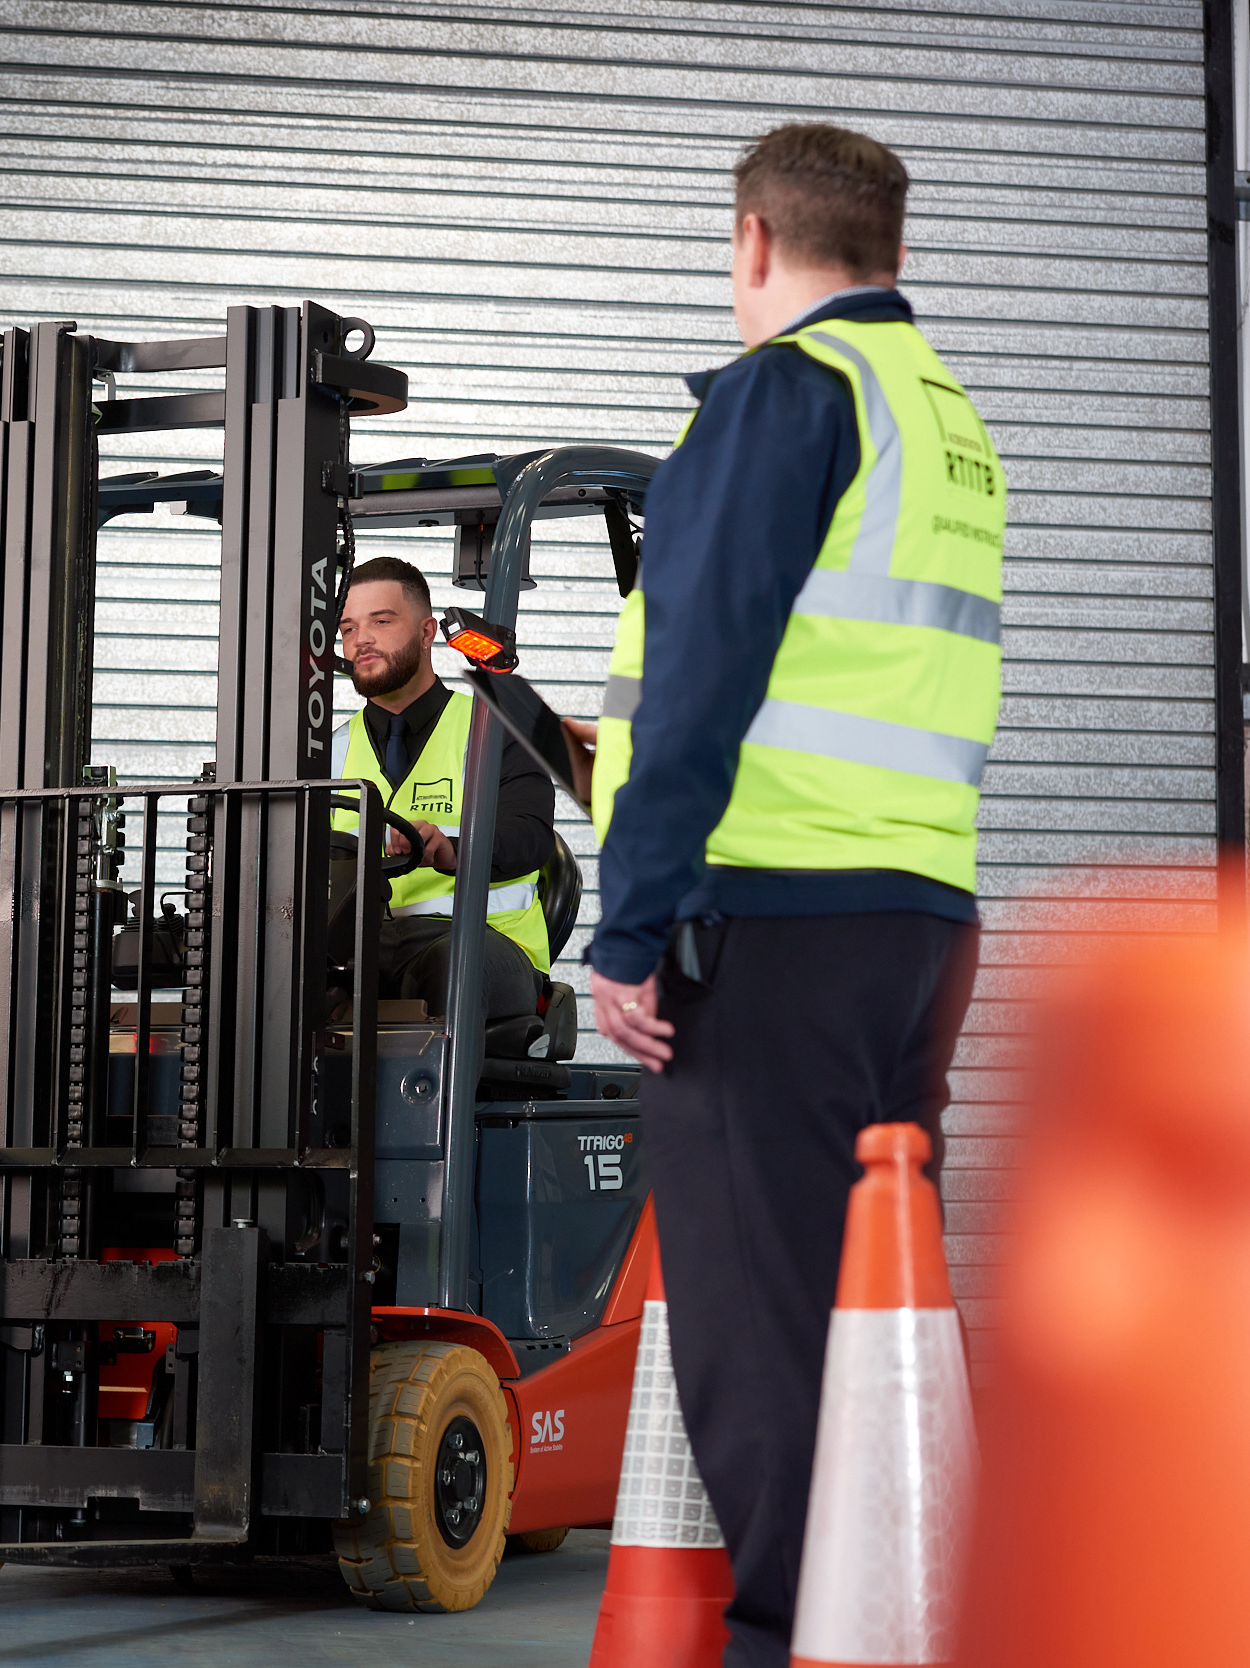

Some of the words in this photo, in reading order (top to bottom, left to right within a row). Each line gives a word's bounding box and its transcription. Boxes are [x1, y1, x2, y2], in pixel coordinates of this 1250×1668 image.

[944, 450, 996, 496] RTITB
[307, 556, 328, 758] TOYOTA
[409, 801, 453, 814] RTITB
[583, 1154, 624, 1191] 15
[530, 1409, 565, 1444] SAS
